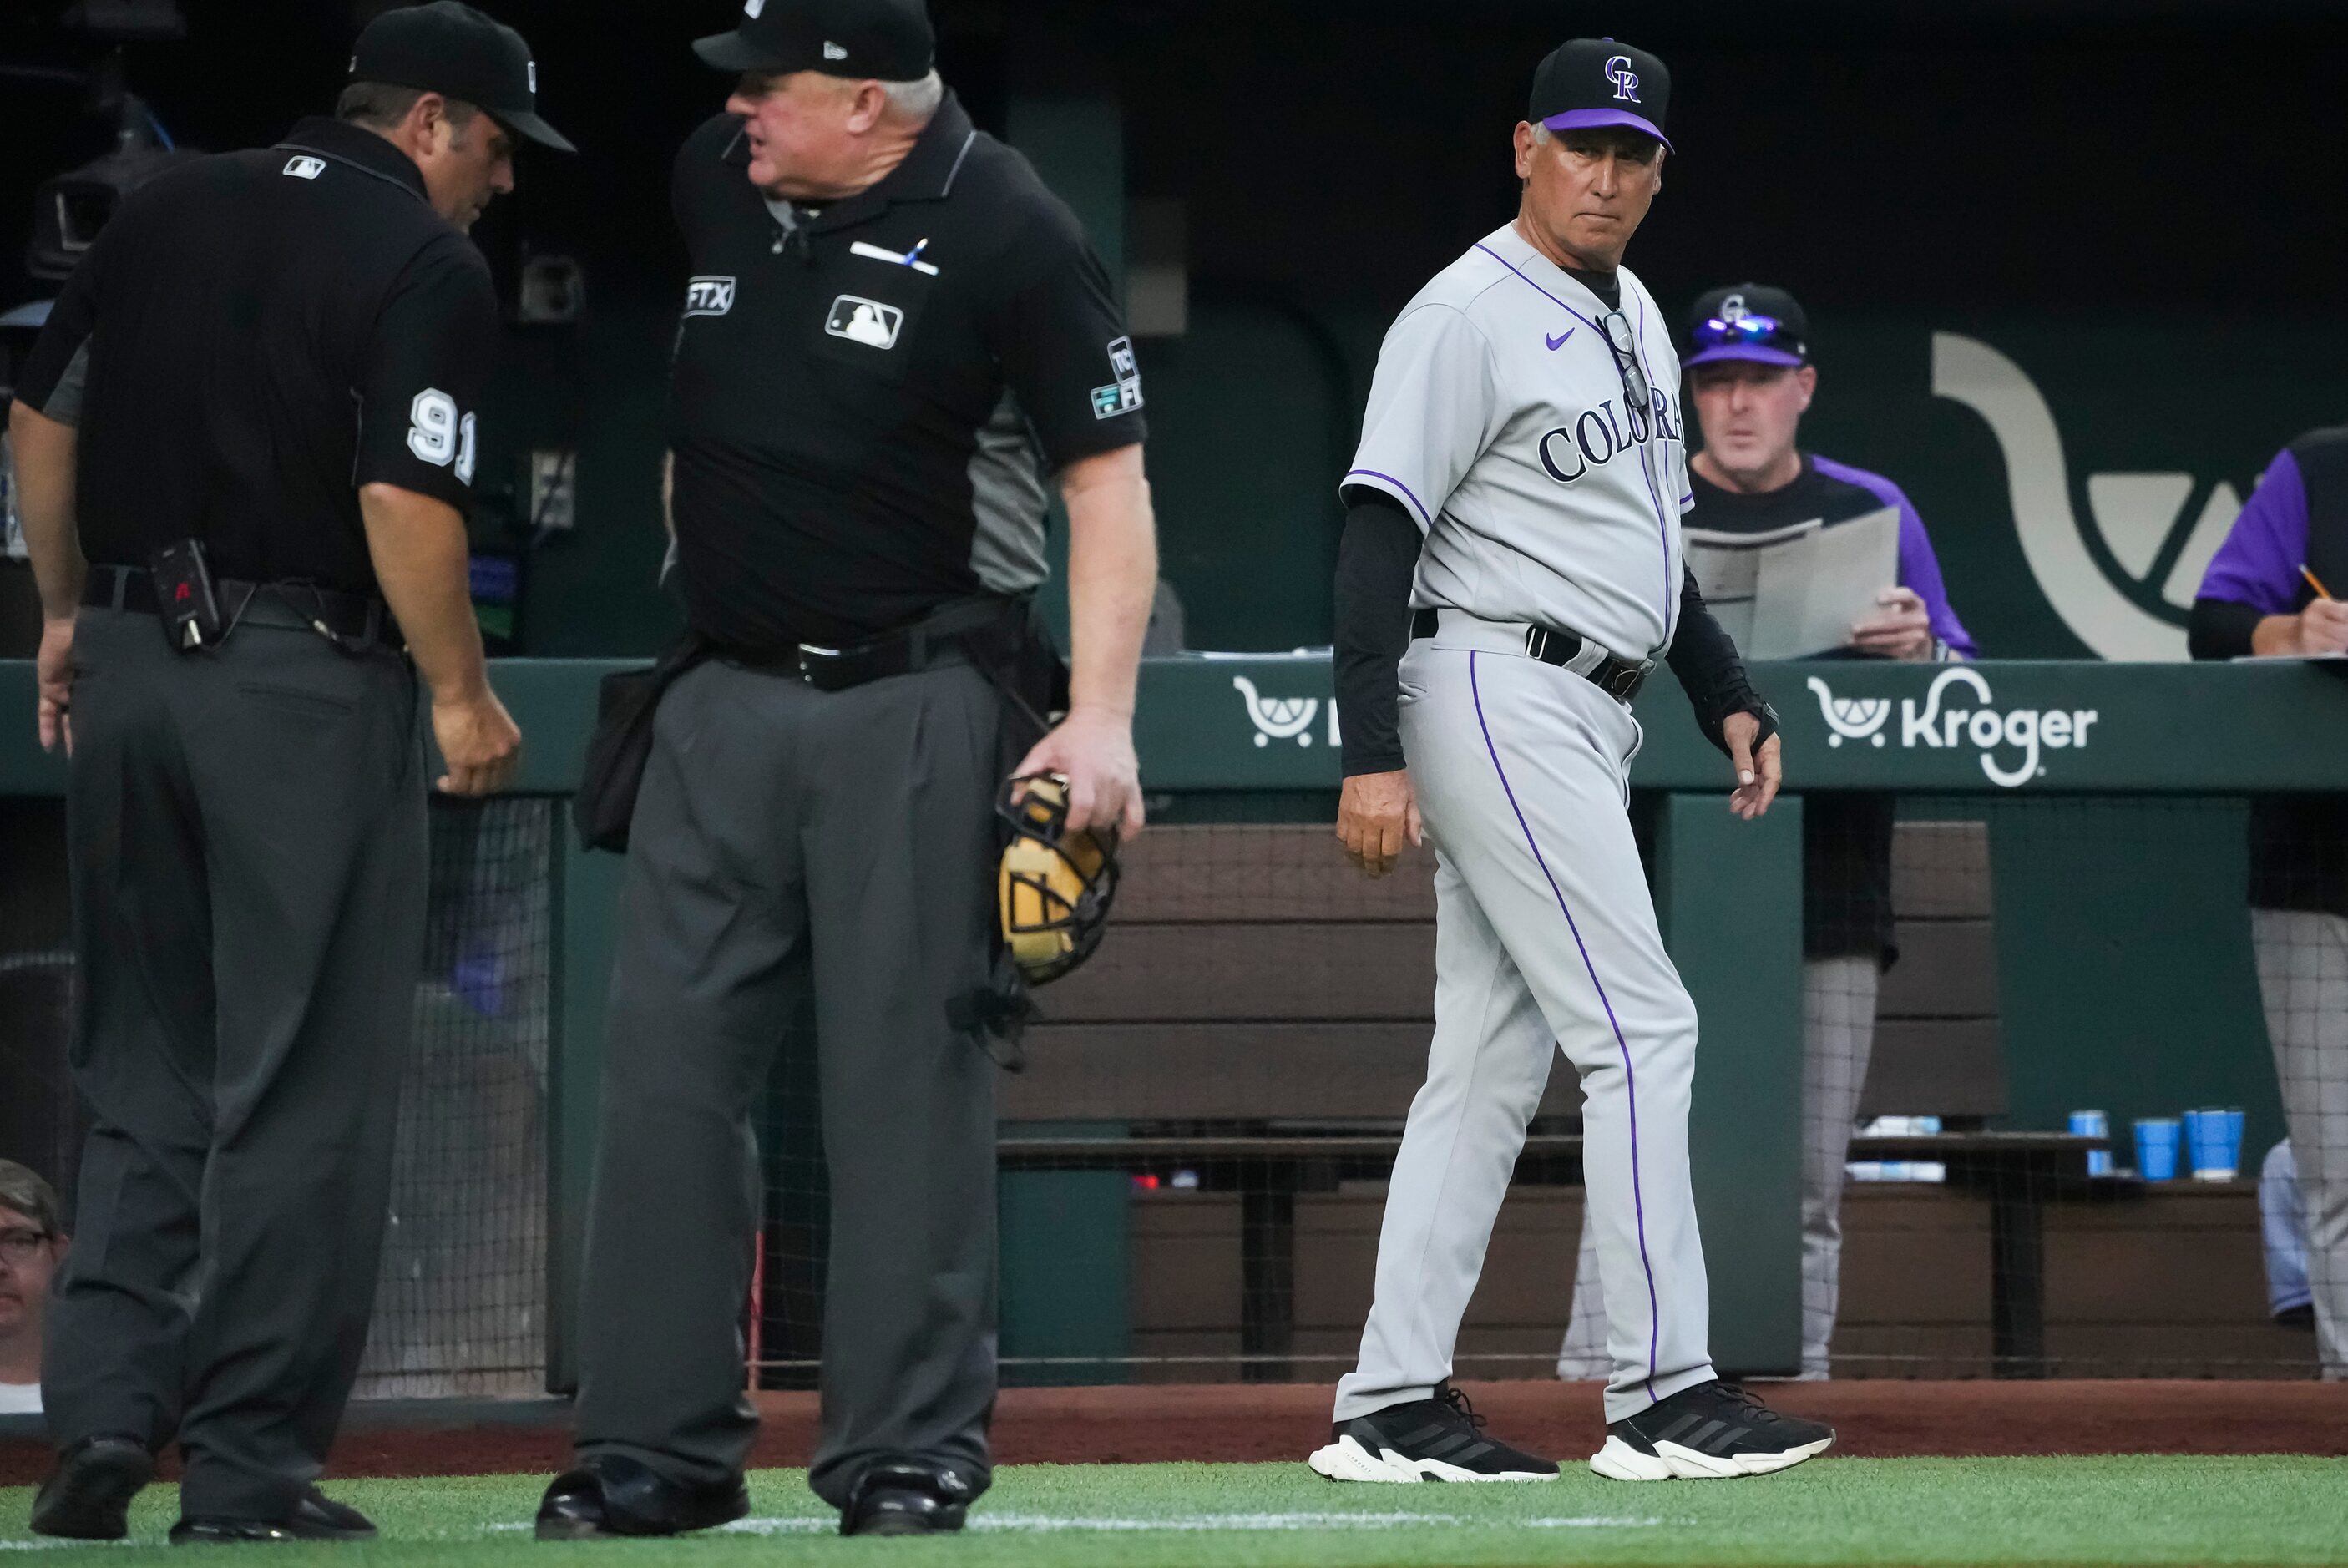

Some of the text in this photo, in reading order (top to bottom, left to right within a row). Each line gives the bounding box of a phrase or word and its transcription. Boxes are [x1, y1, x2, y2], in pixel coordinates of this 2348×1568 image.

[686, 282, 731, 309] FTX
[407, 387, 477, 488] 91
[1900, 666, 2098, 787] Kroger
